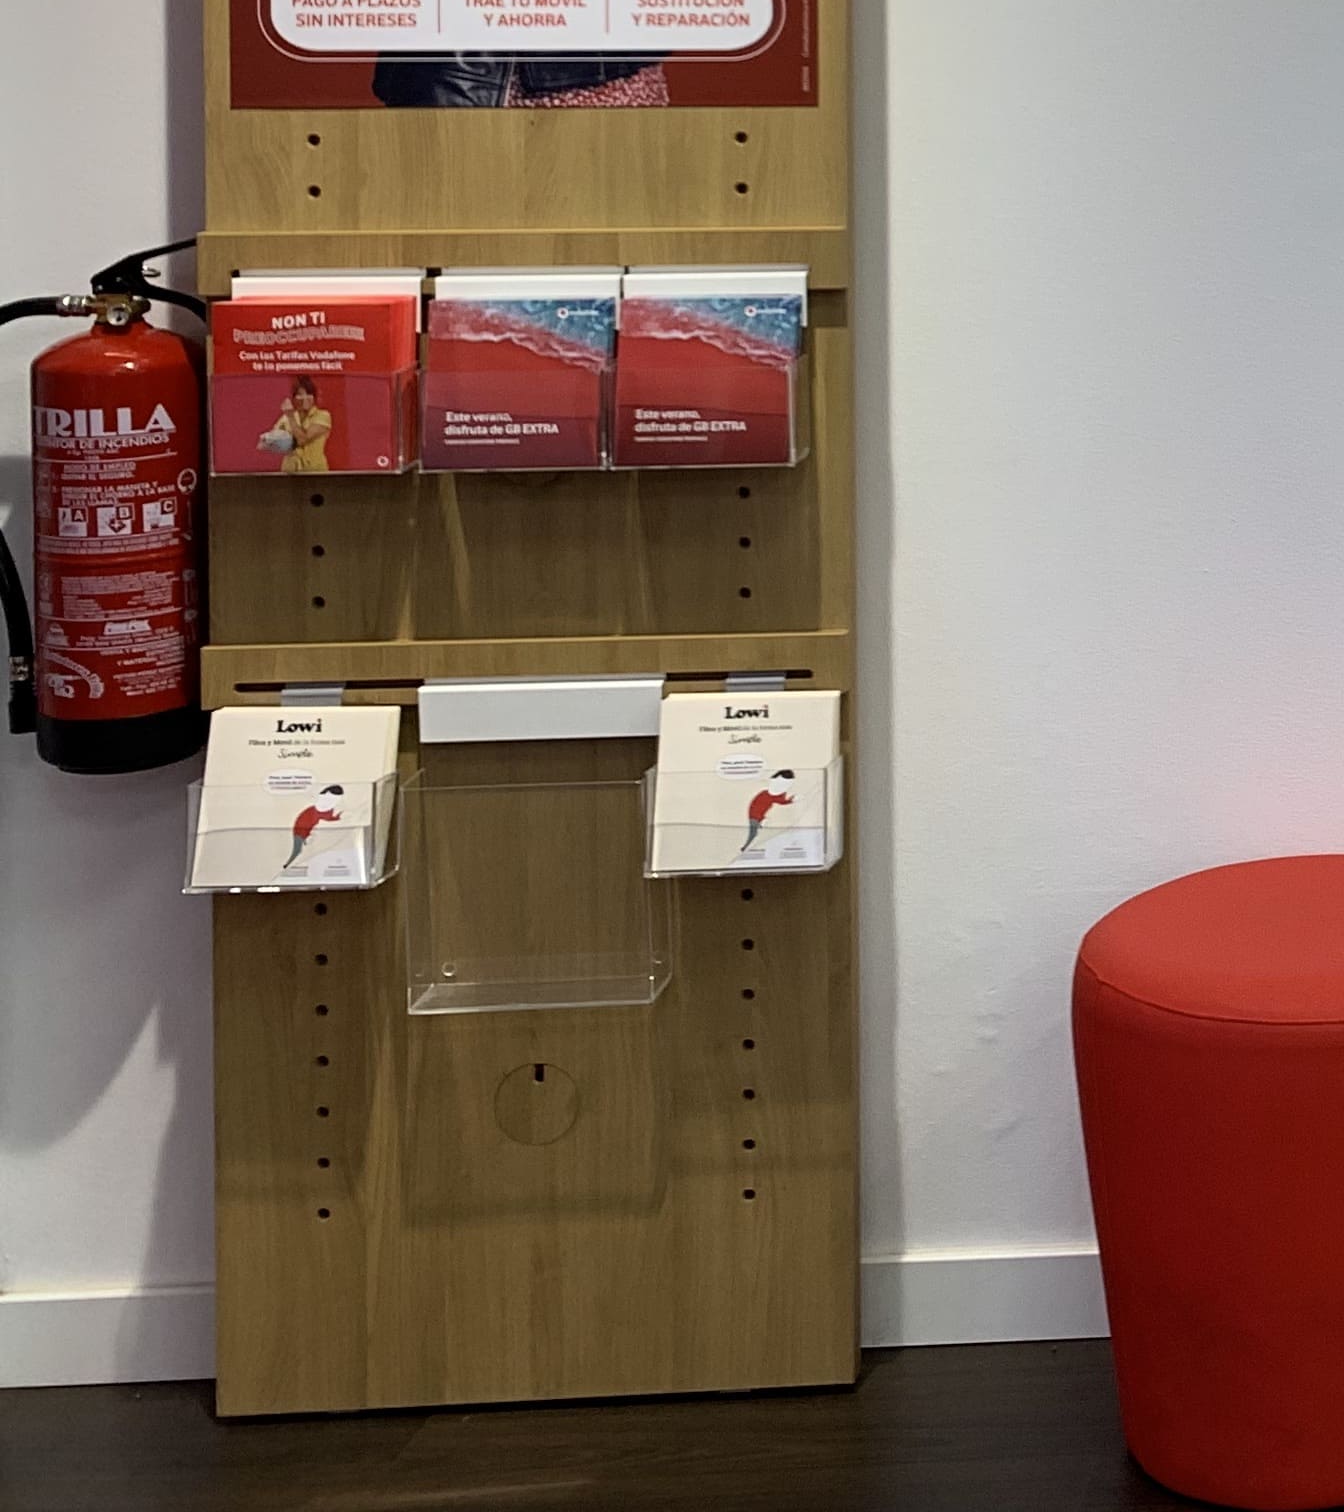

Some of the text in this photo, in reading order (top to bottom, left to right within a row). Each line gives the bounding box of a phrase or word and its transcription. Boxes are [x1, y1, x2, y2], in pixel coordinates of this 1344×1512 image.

[296, 13, 417, 28] SIN INTERESES
[483, 13, 567, 27] Y AHORRA
[631, 9, 751, 27] Y REPARACIÓN
[272, 311, 325, 329] NON TI
[239, 350, 355, 361] Con las Tarifas Vodafone
[253, 362, 263, 371] te
[275, 363, 320, 372] ponemos
[446, 412, 471, 422] Este
[635, 409, 660, 419] Este
[445, 424, 559, 436] disfruta de GB EXTRA
[634, 421, 747, 433] disfruta de GB EXTRA
[97, 433, 170, 449] INCENDIOS
[163, 501, 173, 512] C
[73, 509, 83, 521] A
[725, 705, 769, 719] Lowi
[276, 718, 322, 733] Lowi
